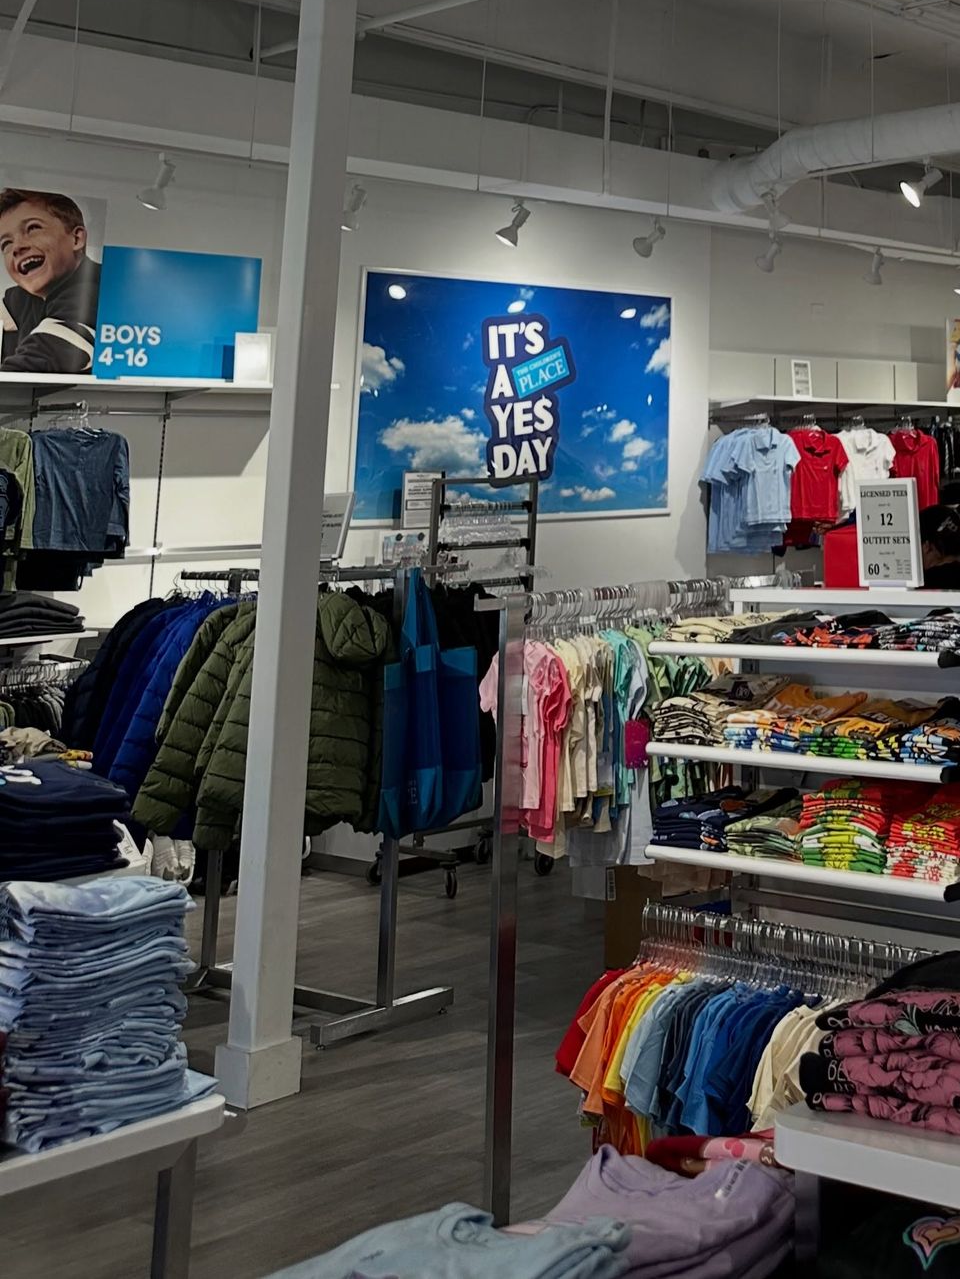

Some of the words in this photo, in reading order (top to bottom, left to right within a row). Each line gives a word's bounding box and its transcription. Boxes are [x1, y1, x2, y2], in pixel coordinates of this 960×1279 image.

[100, 324, 161, 346] BOYS
[488, 321, 545, 360] IT'S
[98, 346, 148, 367] 4-16
[491, 364, 514, 399] A
[519, 358, 566, 393] PLACE
[492, 436, 553, 479] DAY
[860, 490, 891, 498] LICENSED
[892, 489, 908, 498] TEES
[880, 512, 894, 526] 12
[863, 536, 890, 545] OUTFIT
[892, 536, 910, 545] SETS
[868, 563, 880, 575] 60
